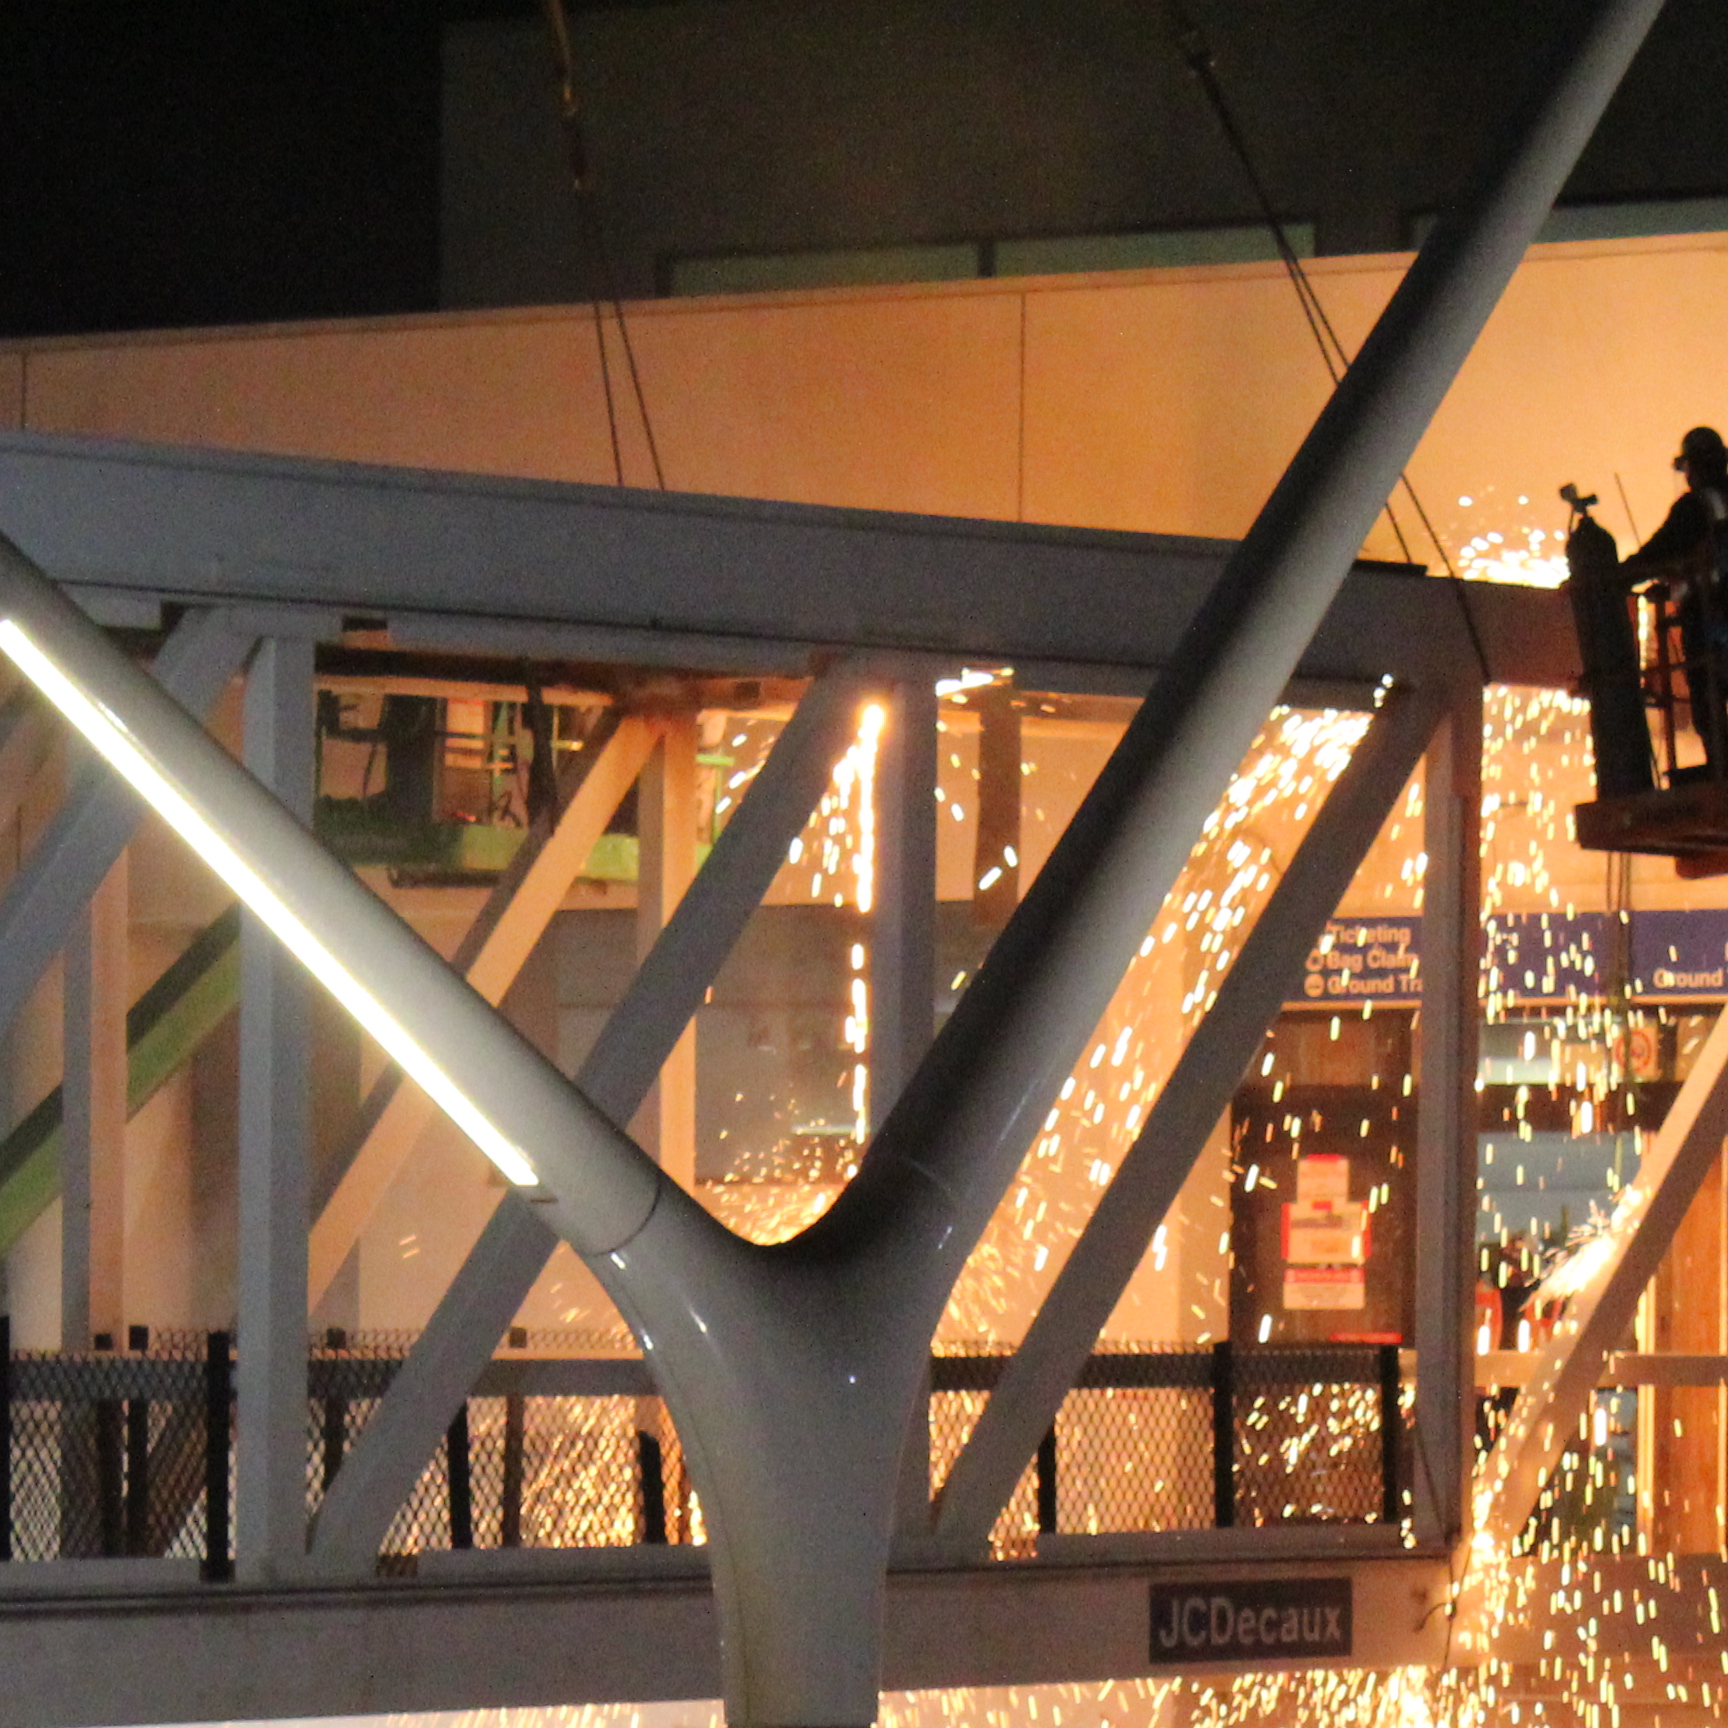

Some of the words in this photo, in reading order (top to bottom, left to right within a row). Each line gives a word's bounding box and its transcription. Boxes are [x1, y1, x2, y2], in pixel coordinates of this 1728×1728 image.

[1327, 974, 1394, 994] Gound
[1653, 968, 1723, 988] Gound
[1159, 1596, 1341, 1648] JCDecaux
